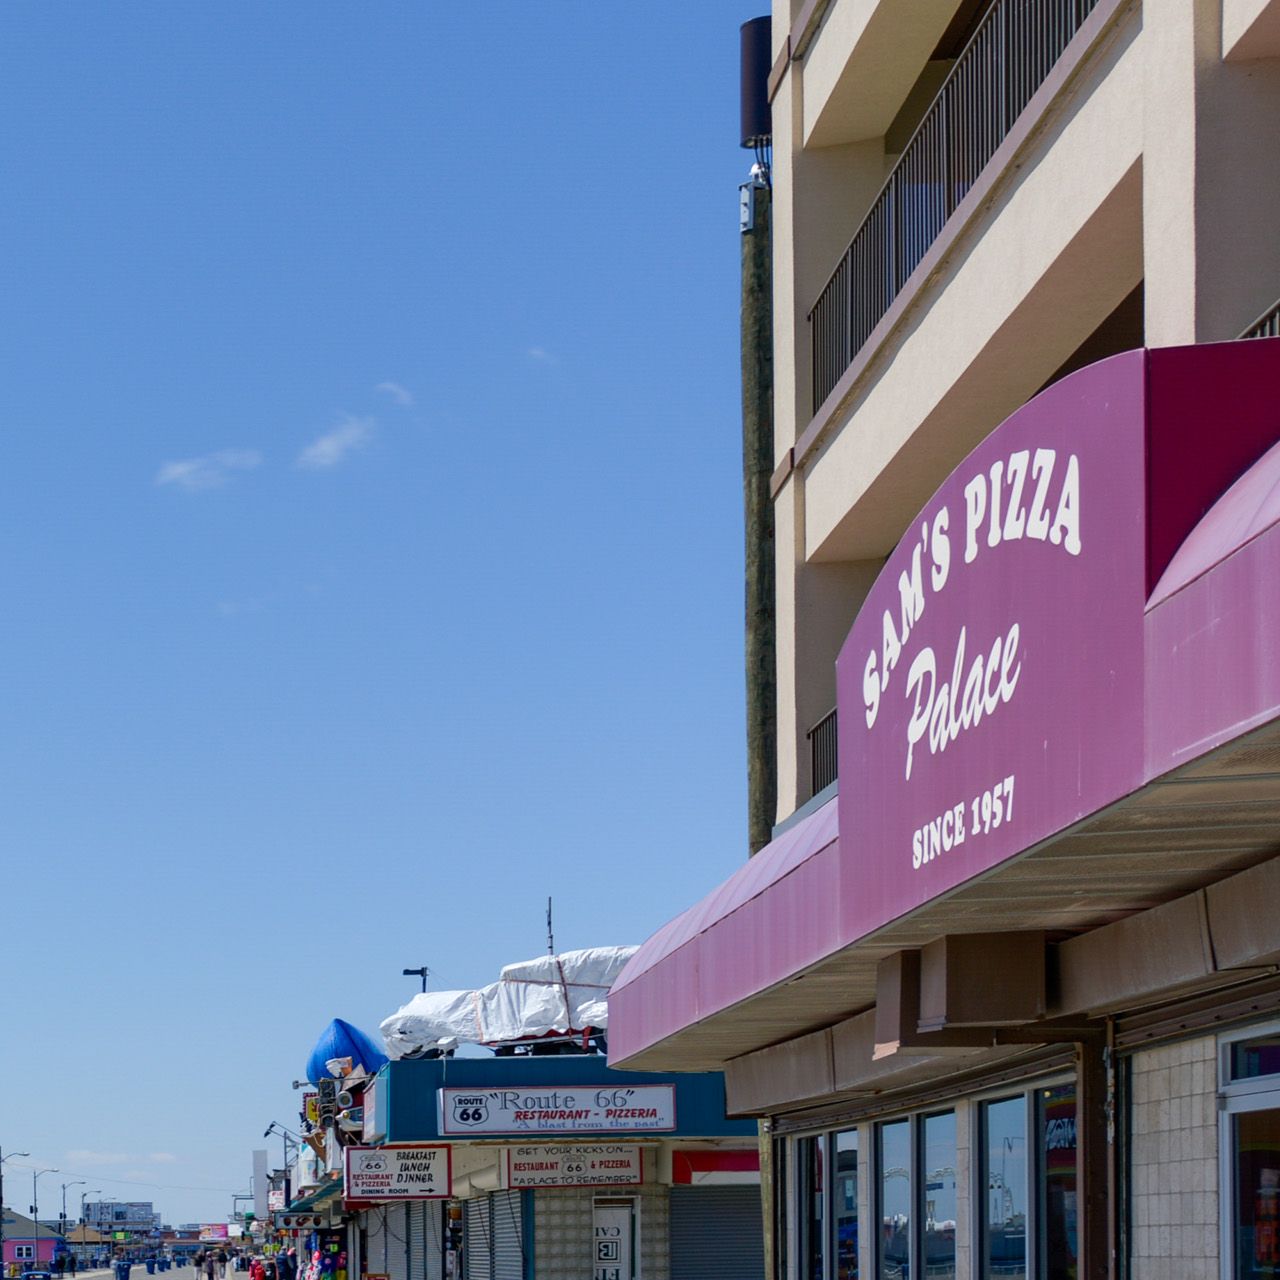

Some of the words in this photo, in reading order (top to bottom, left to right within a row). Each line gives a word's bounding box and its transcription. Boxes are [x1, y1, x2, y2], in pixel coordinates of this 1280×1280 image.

[862, 505, 951, 730] SAM'S
[963, 448, 1082, 565] PIZZA
[905, 622, 1022, 782] Palace
[912, 801, 965, 871] SINCE
[971, 774, 1015, 836] 1957
[457, 1098, 483, 1106] ROUTE
[459, 1108, 483, 1122] 66
[514, 1109, 592, 1121] RESTAURANT
[605, 1108, 658, 1119] PIZZERIA
[537, 1118, 566, 1129] blast
[571, 1119, 603, 1129] from
[608, 1119, 631, 1128] the
[396, 1151, 437, 1161] BREAKFAST
[517, 1147, 539, 1156] GET
[544, 1146, 573, 1155] YOUR
[576, 1146, 605, 1154] KICKS
[365, 1162, 382, 1170] 66
[400, 1162, 431, 1172] LUNCH
[513, 1161, 560, 1172] RESTAURANT
[566, 1163, 583, 1173] 66
[590, 1161, 596, 1169] &
[599, 1159, 632, 1169] PIZZERIA
[396, 1173, 434, 1184] DINNER
[527, 1176, 558, 1185] PLACE
[560, 1176, 574, 1184] TO
